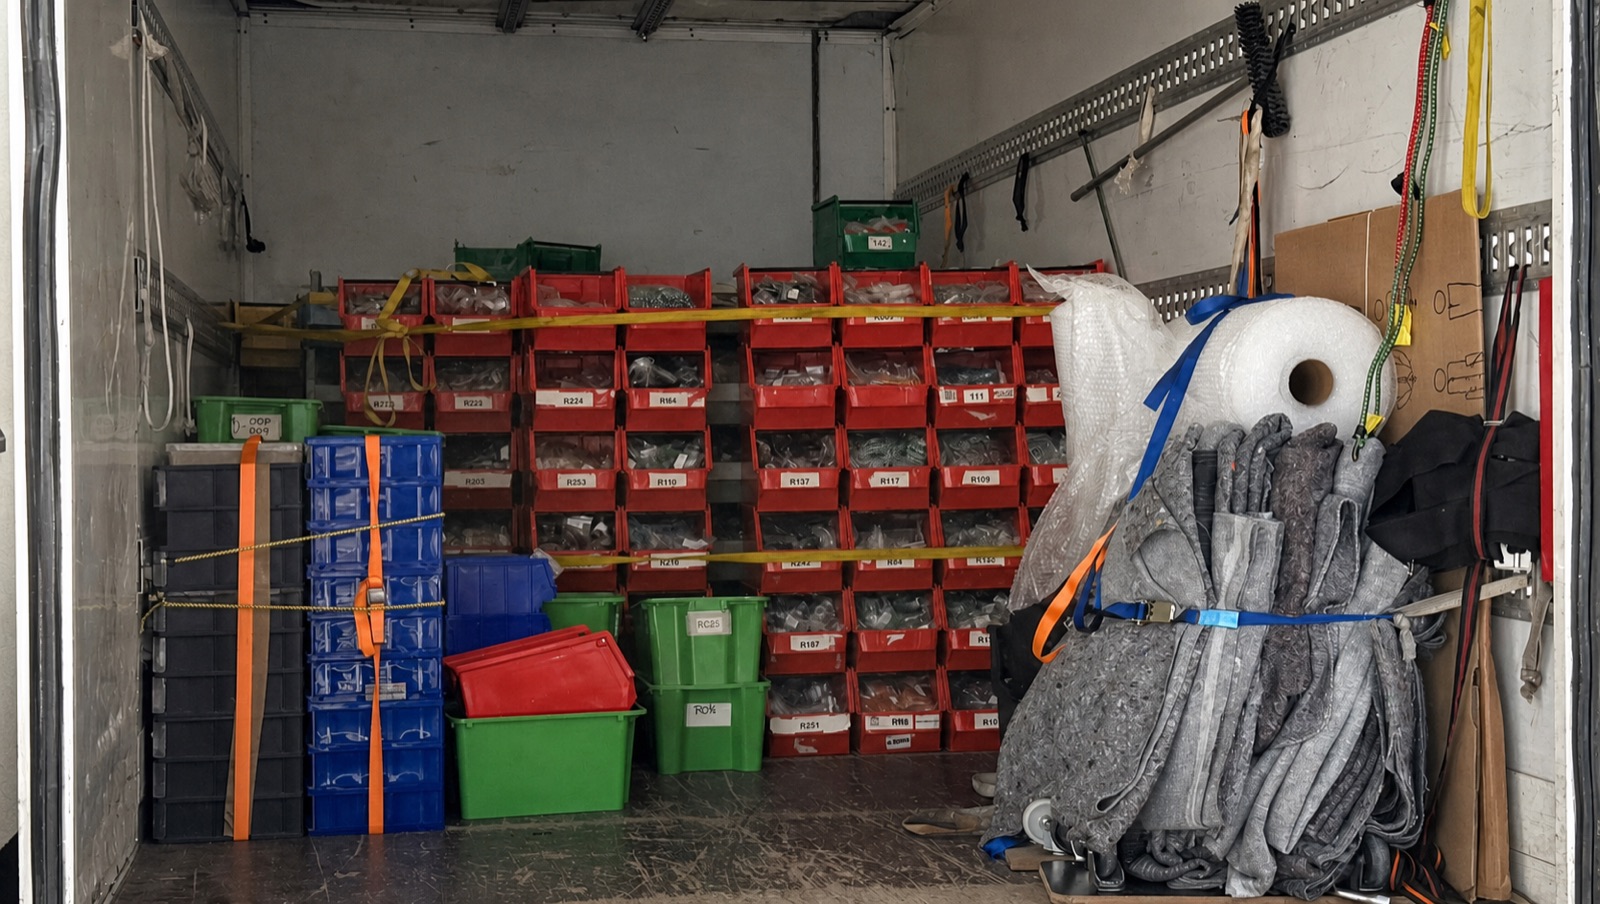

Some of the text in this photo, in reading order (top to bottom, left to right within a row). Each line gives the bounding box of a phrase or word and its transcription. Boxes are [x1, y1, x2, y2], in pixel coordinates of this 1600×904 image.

[872, 240, 888, 248] 142
[969, 392, 984, 400] 111
[880, 477, 900, 485] R117
[697, 620, 720, 629] RC25
[799, 721, 820, 730] R251
